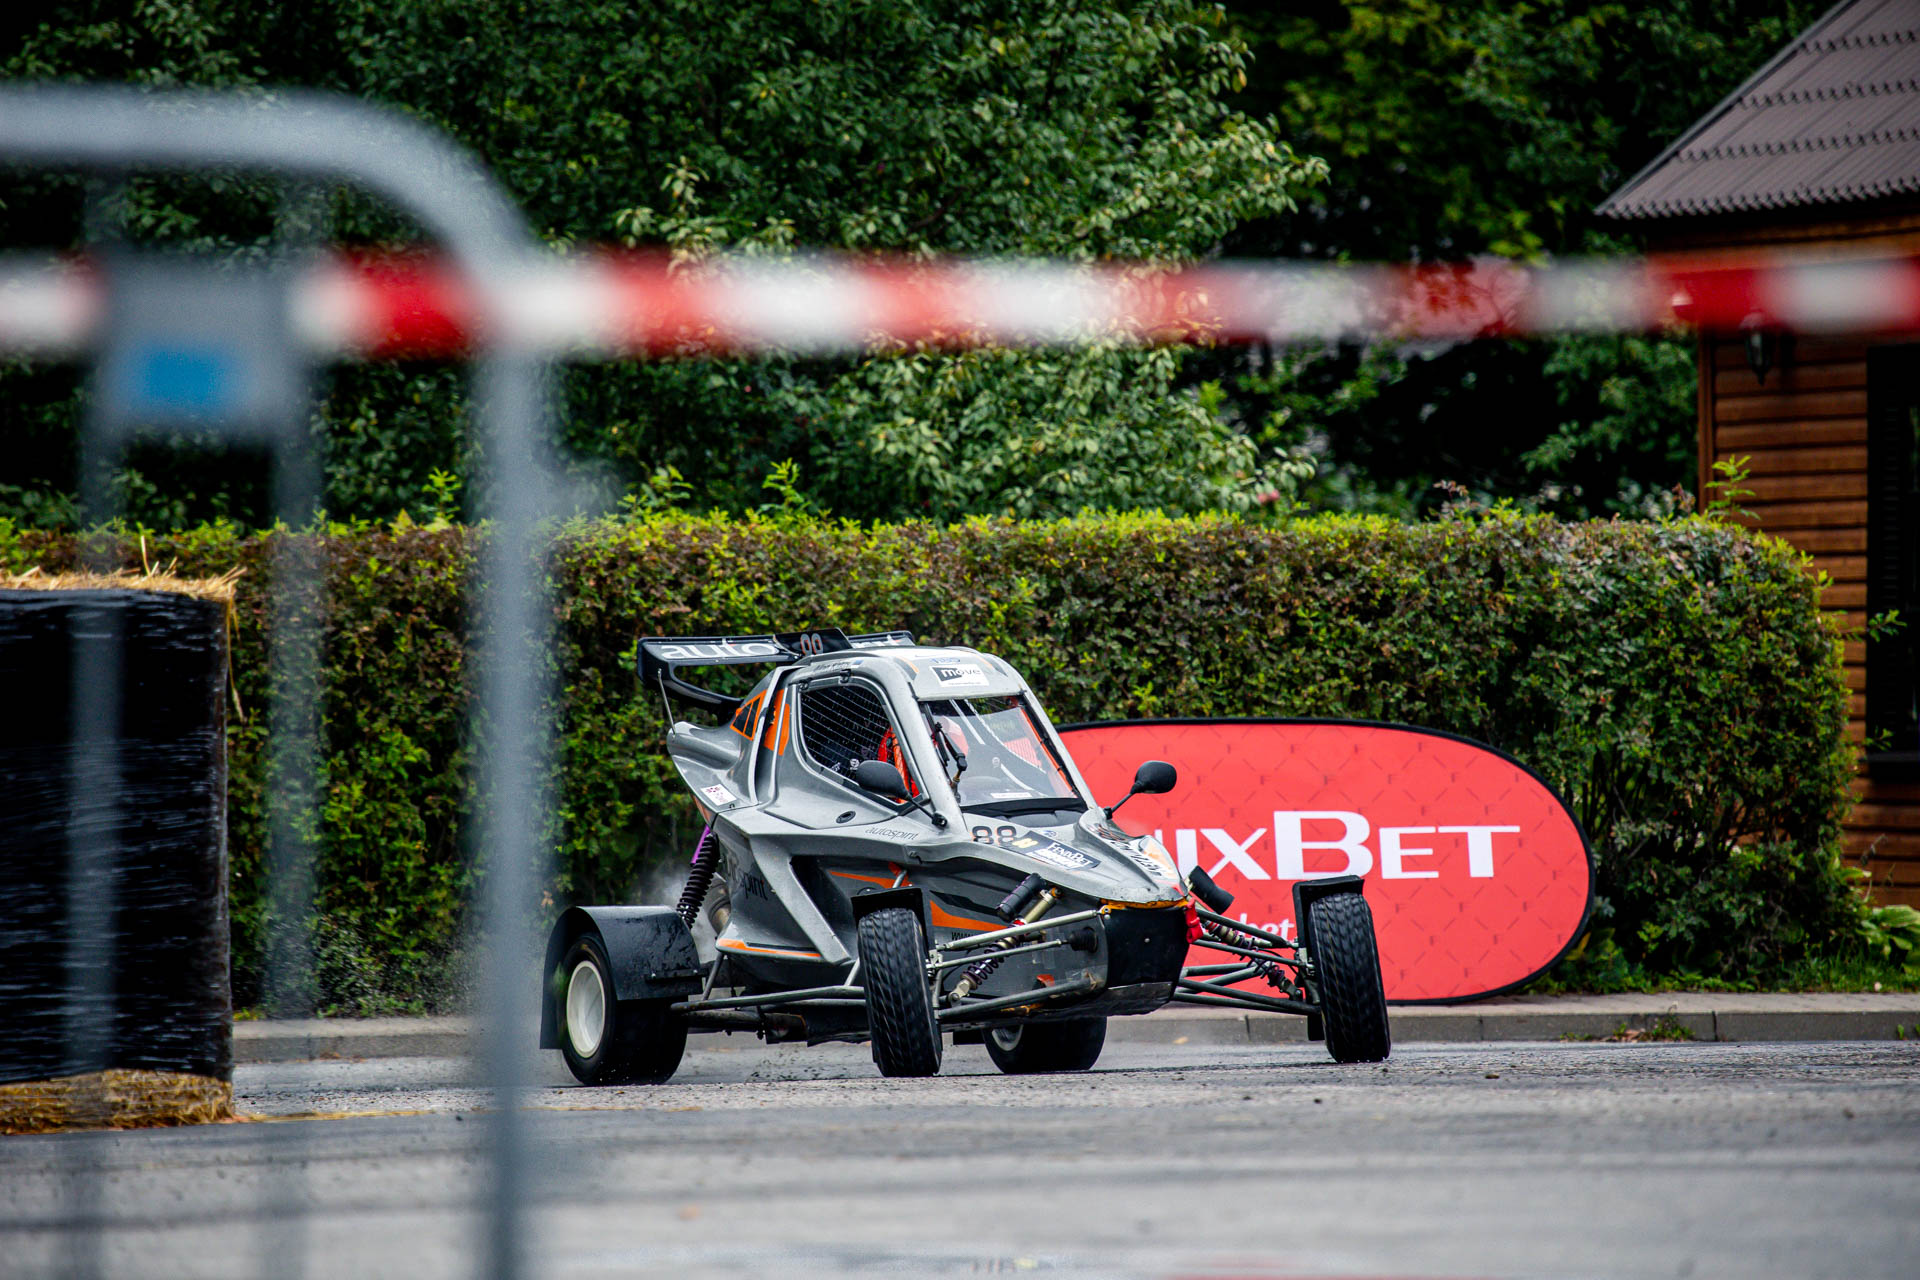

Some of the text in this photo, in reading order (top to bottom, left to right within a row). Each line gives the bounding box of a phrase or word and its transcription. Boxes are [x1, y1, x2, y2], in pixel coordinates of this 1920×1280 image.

[661, 642, 780, 660] auto
[940, 669, 981, 678] move
[970, 825, 1017, 847] 88
[1154, 810, 1521, 881] IXBET
